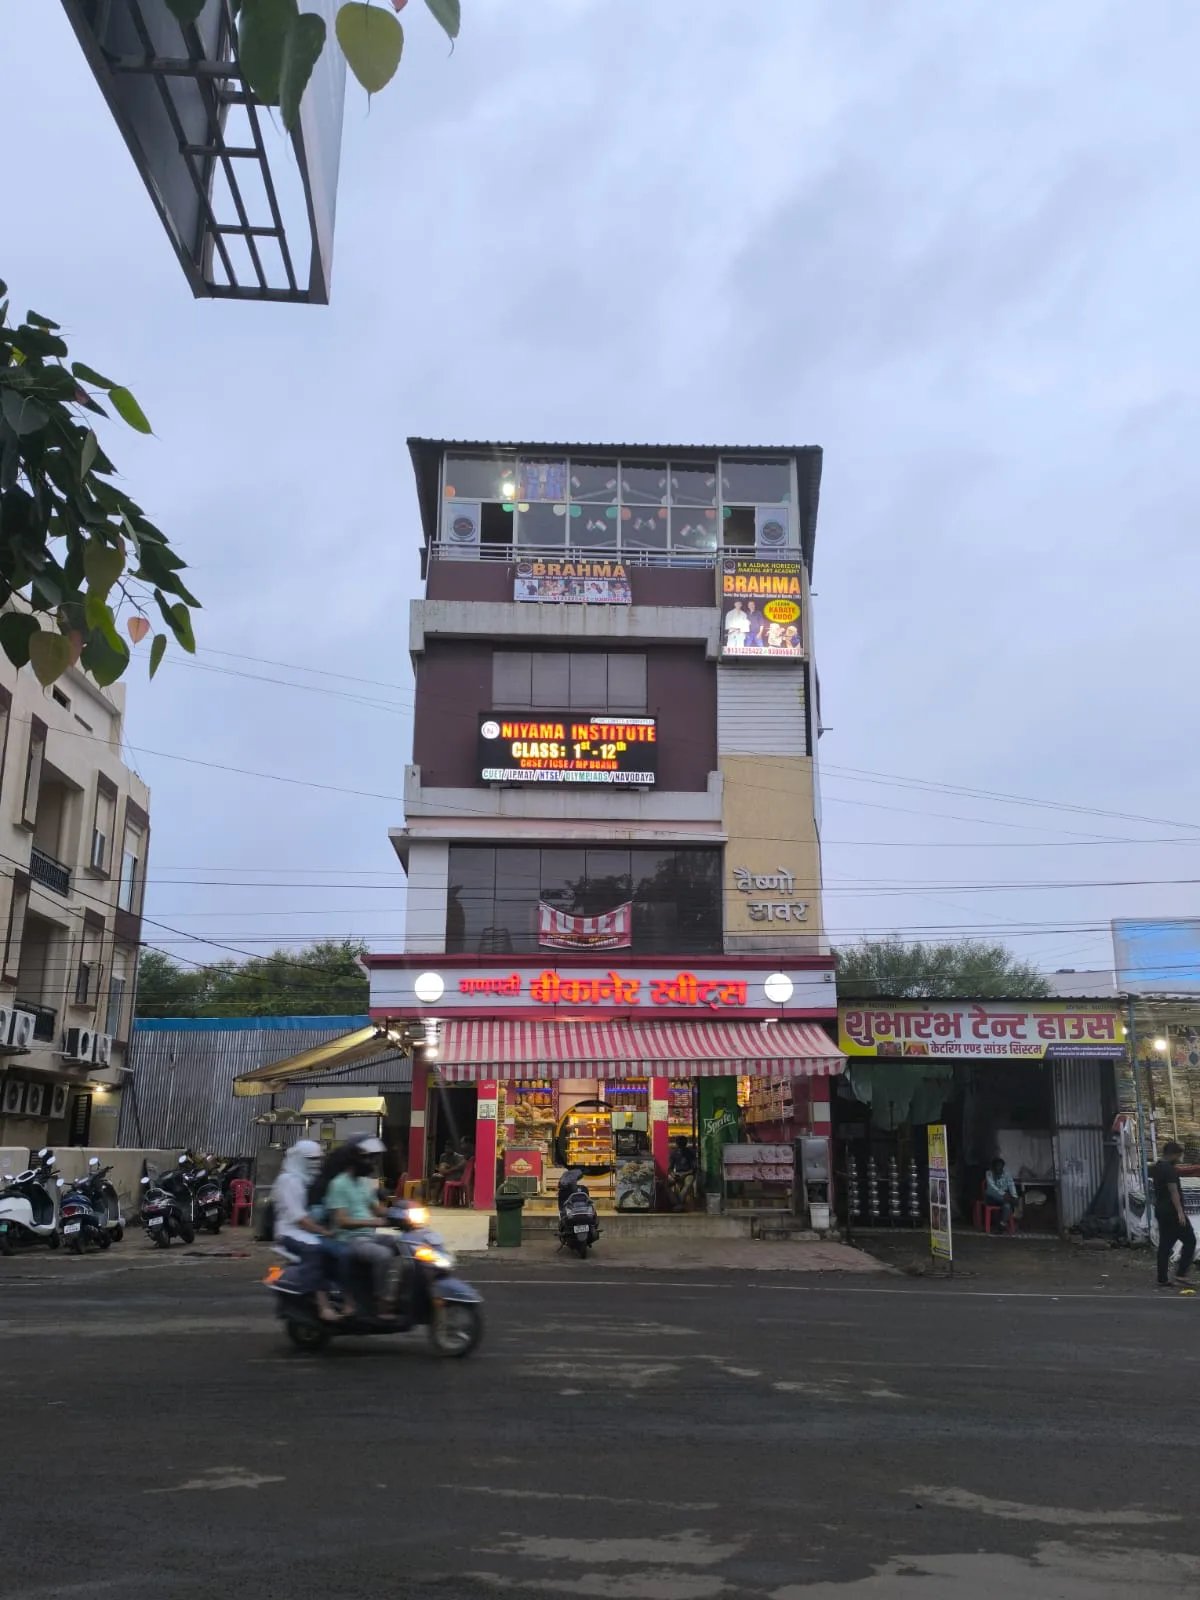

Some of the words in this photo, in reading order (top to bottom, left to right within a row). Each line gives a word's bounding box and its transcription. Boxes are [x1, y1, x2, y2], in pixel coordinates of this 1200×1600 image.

[532, 563, 626, 577] BRAHMA
[723, 575, 800, 594] BRAHMA
[502, 723, 565, 740] NIYAMA
[571, 724, 656, 741] INSTITUTE
[512, 741, 565, 759] CLASS:
[529, 970, 640, 1004] बीकानेर
[846, 1004, 963, 1046] शुभारंभ
[968, 1004, 1028, 1039] टेन्ट
[1033, 1013, 1116, 1039] हाउस
[963, 1043, 981, 1054] एण्ड
[1009, 1041, 1042, 1055] सिस्टम
[706, 1112, 732, 1134] Sprite
